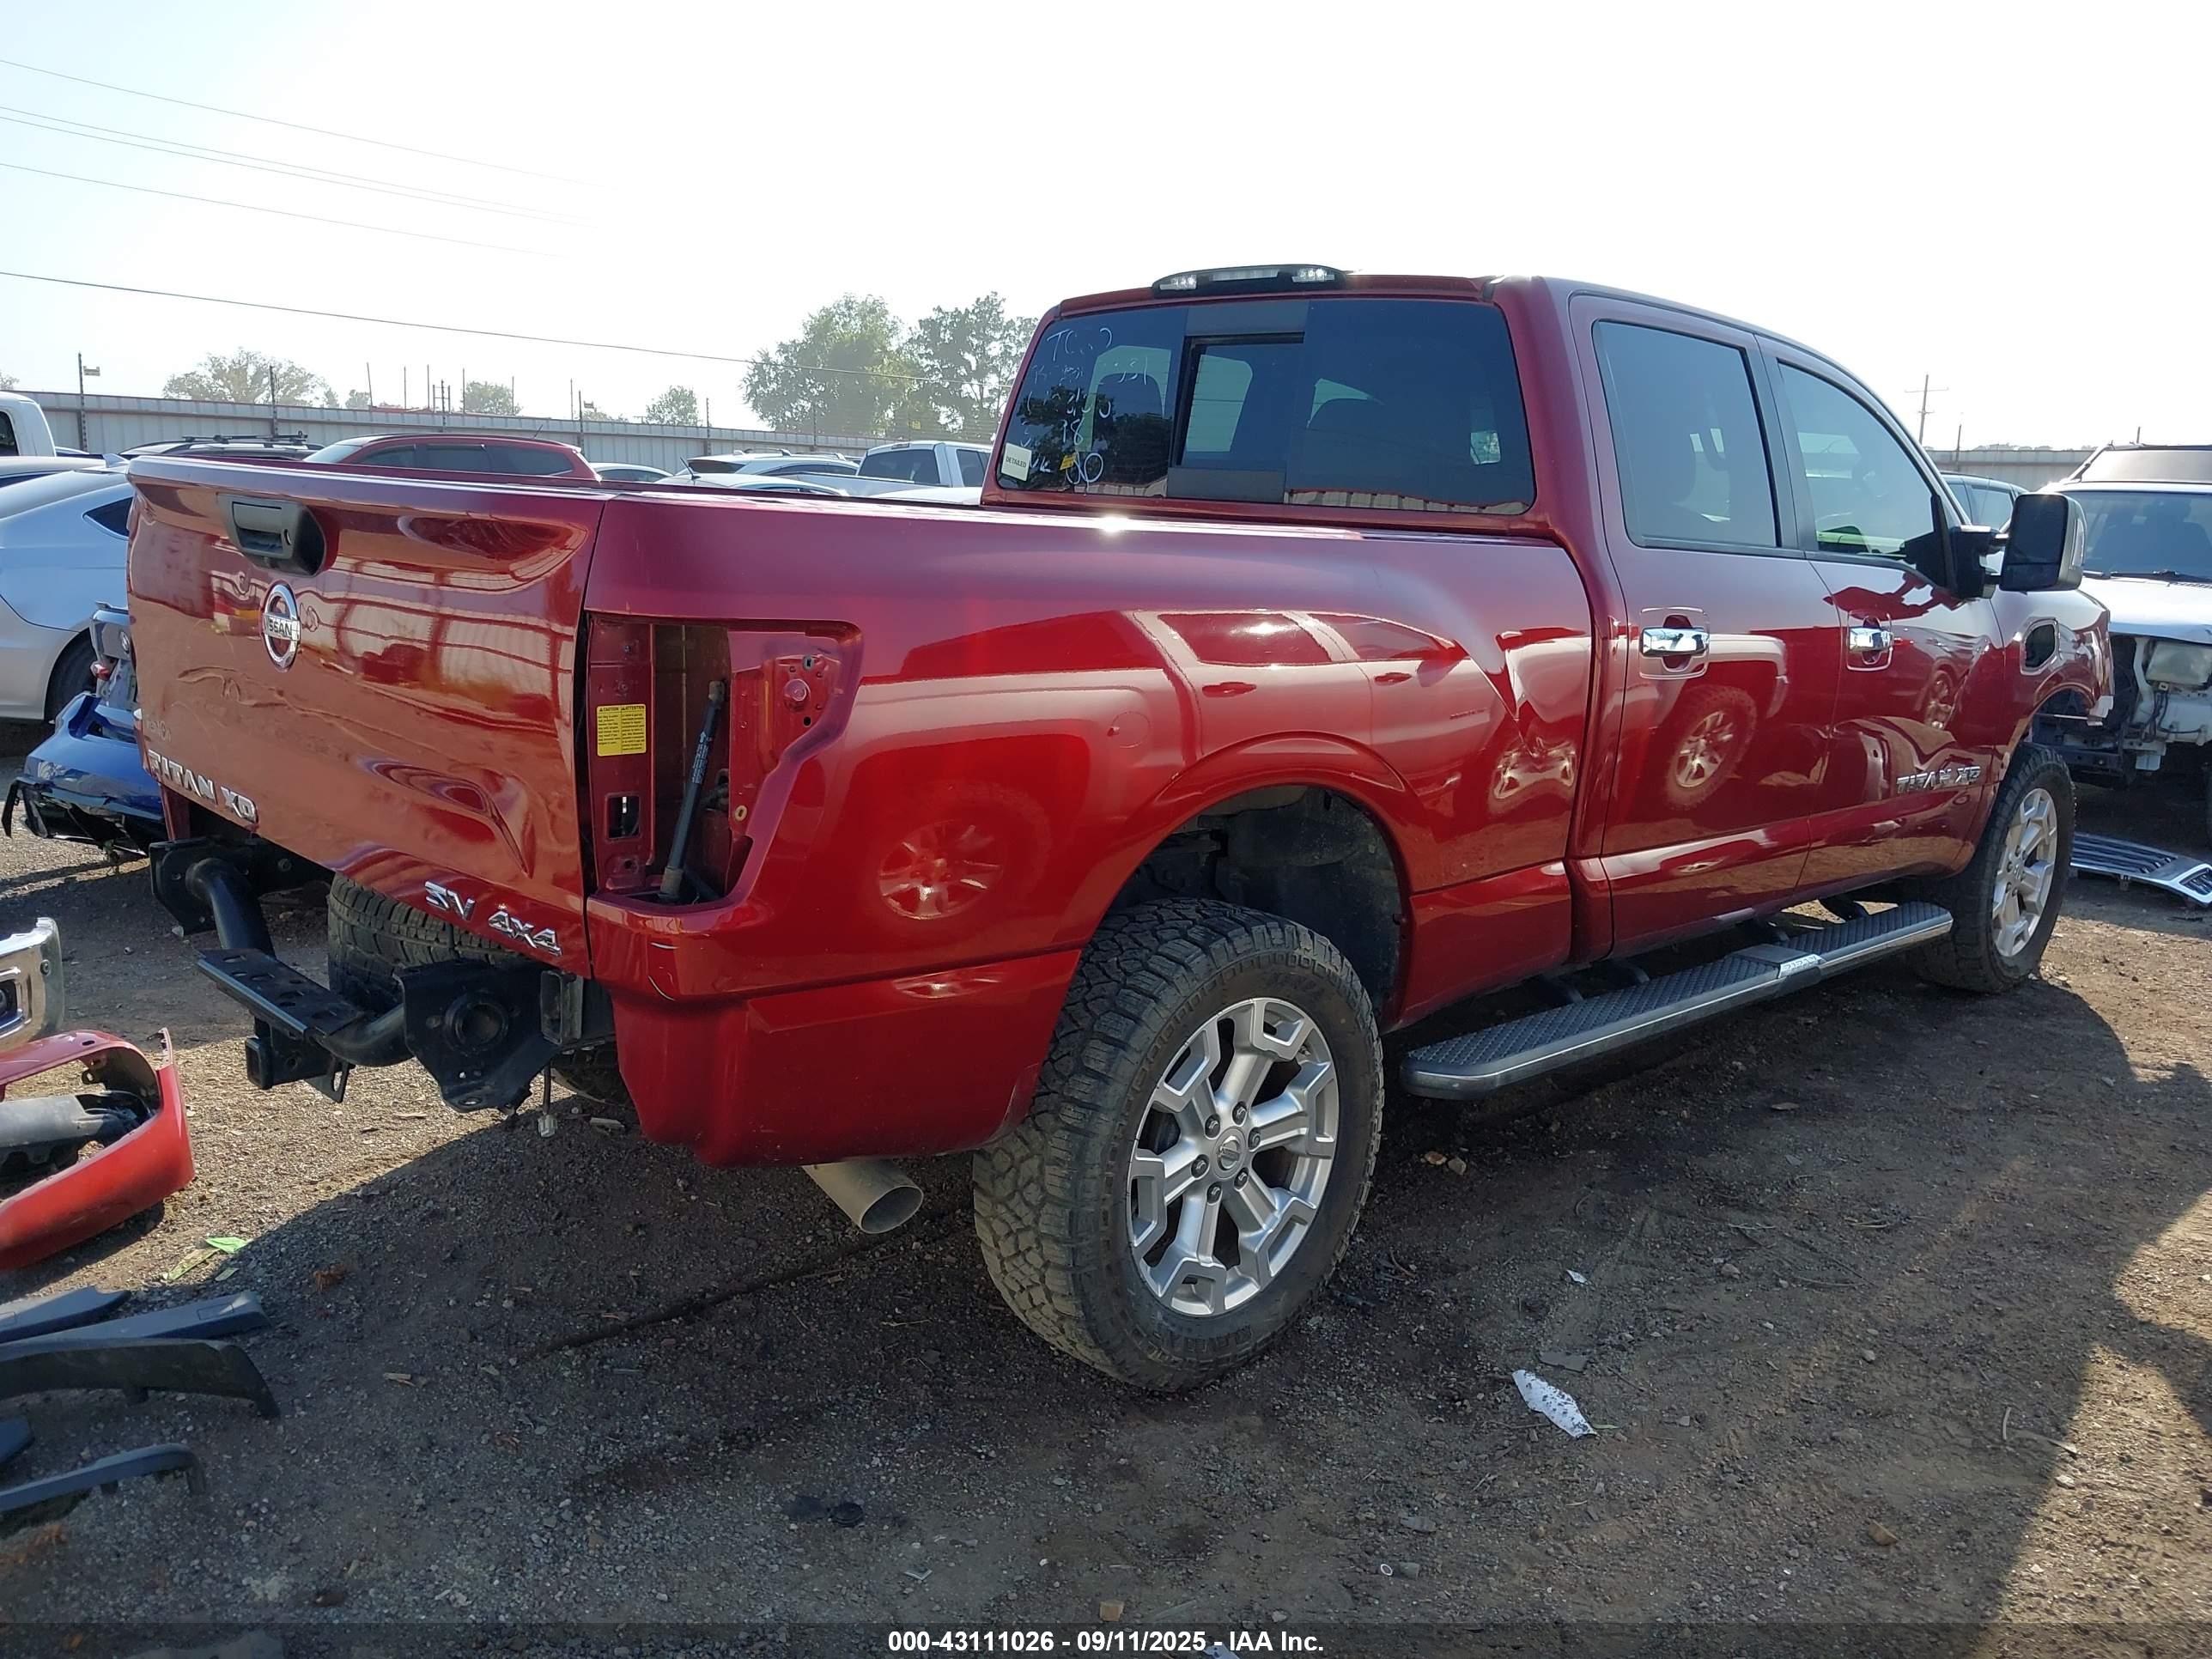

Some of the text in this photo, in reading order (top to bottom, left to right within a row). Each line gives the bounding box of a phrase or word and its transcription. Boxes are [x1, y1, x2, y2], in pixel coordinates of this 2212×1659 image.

[1006, 456, 1027, 469] DETAILED
[148, 749, 258, 823] TITAN XD
[1896, 766, 1982, 793] TITAN XD
[424, 880, 476, 921] SV
